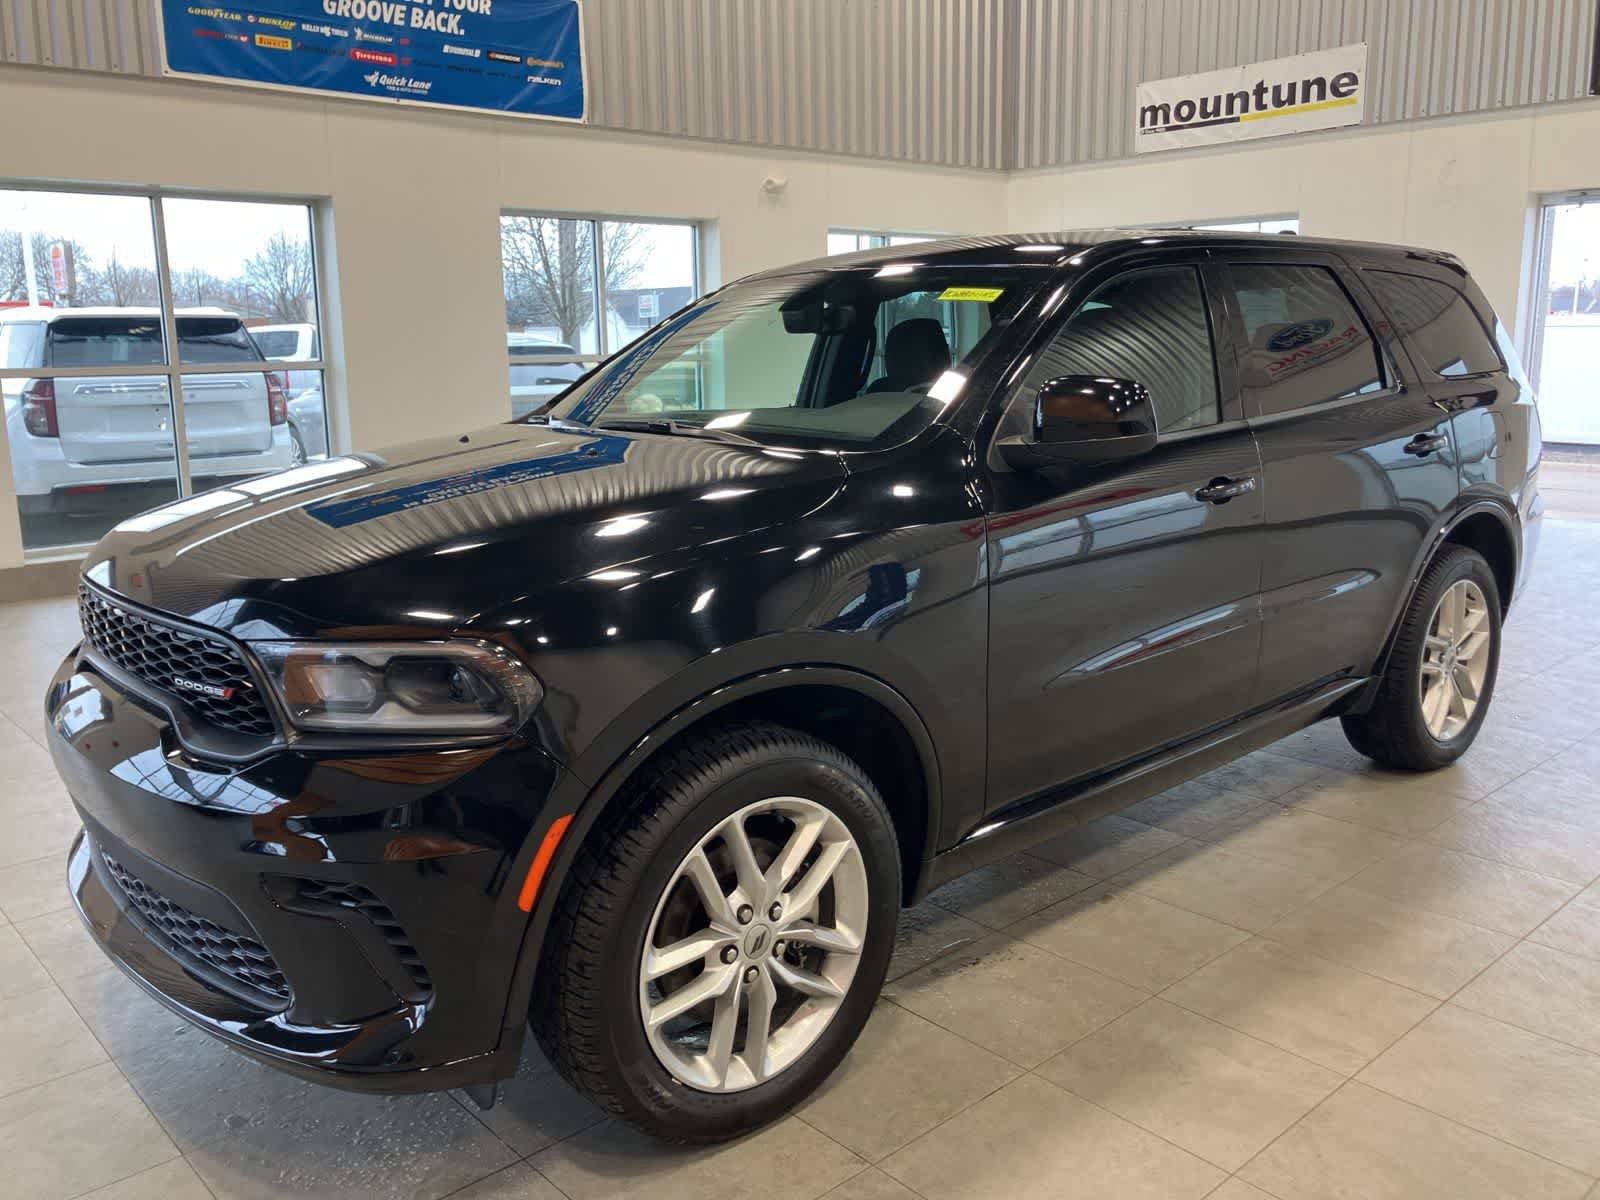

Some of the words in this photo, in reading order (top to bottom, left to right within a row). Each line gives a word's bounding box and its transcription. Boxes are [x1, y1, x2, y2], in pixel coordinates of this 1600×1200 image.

[187, 7, 242, 22] GOODYEAR
[258, 16, 297, 29] DUNLOP
[323, 0, 405, 26] GROOVE
[410, 7, 465, 35] BACK.
[379, 74, 407, 88] Quick
[407, 78, 432, 90] Lane
[527, 75, 562, 86] FALKEN
[1139, 71, 1359, 128] mountune
[174, 677, 225, 697] DODGE
